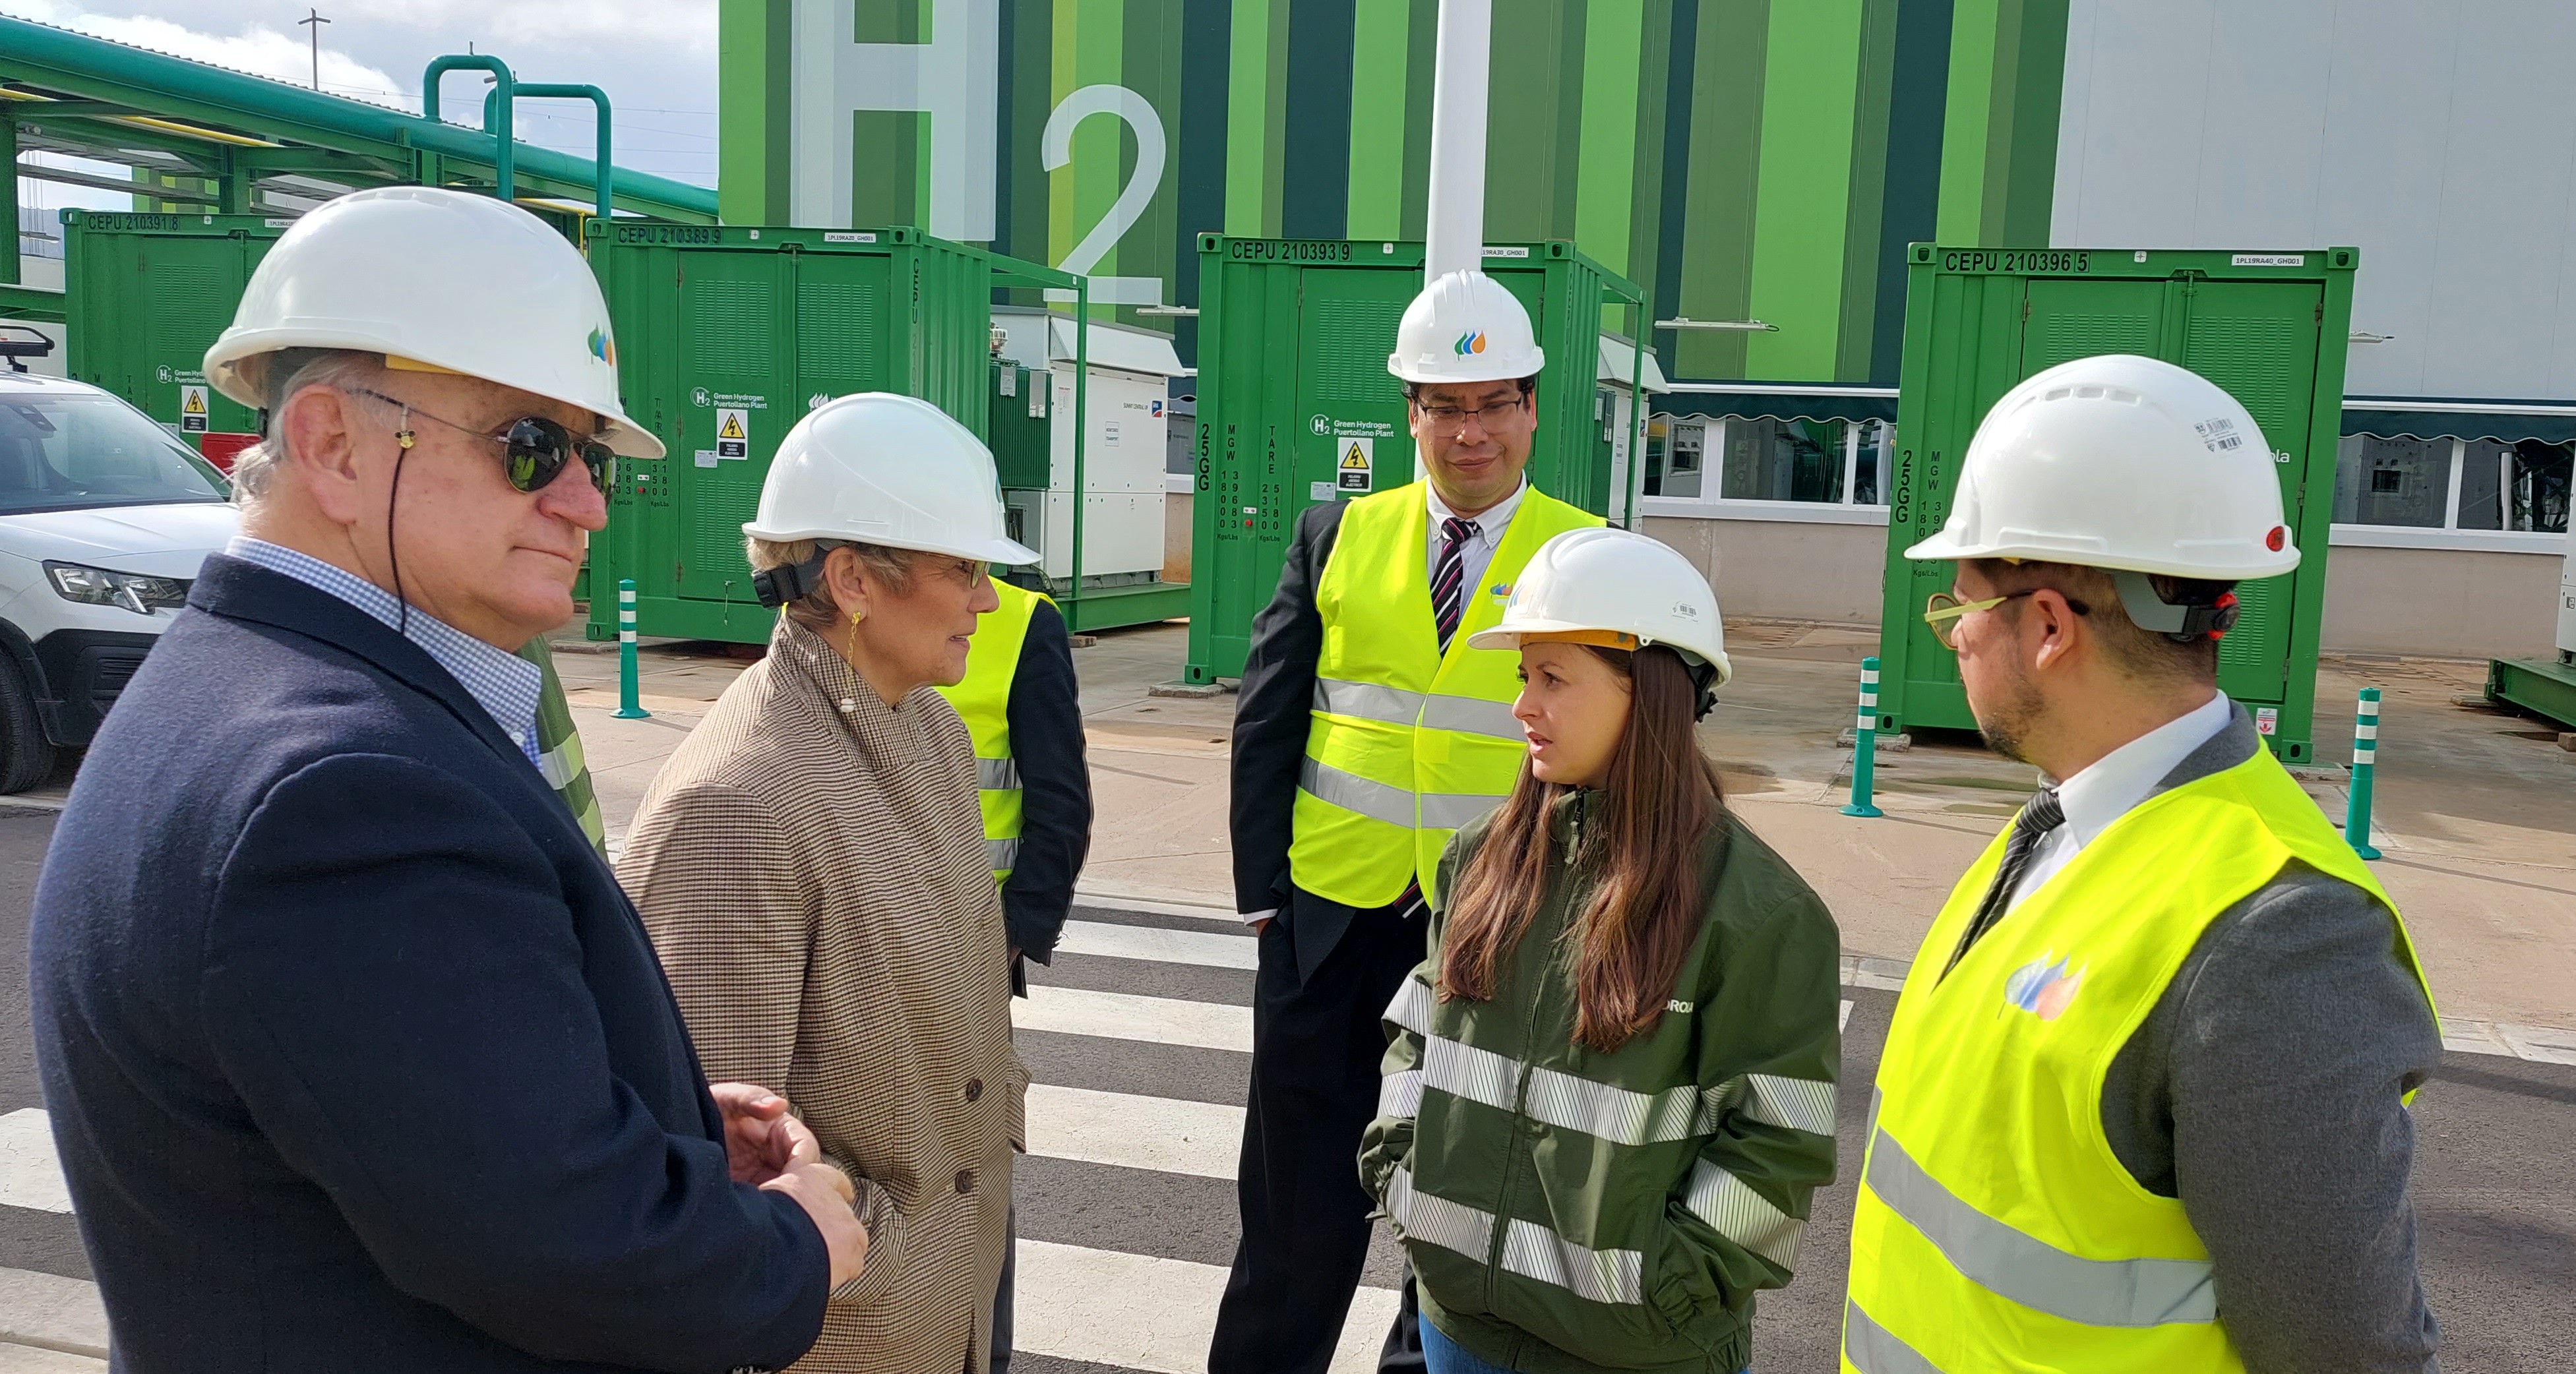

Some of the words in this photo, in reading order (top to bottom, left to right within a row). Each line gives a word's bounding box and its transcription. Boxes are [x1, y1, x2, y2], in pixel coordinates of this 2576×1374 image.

[88, 215, 121, 230] CEPU
[126, 216, 166, 231] 210391
[171, 216, 179, 231] 8
[618, 227, 656, 244] CEPU
[660, 228, 709, 245] 210389
[713, 228, 720, 245] 9
[1232, 242, 1275, 260] CEPU
[1281, 243, 1336, 261] 210393
[1341, 243, 1350, 262] 9
[1945, 252, 1998, 271] CEPU
[2004, 253, 2071, 272] 210396
[2077, 253, 2088, 273] 5
[733, 394, 764, 402] Hydrogen
[1356, 421, 1392, 430] Hydrogen
[1226, 424, 1235, 461] MGW
[1198, 423, 1210, 491] 25GG
[1928, 450, 1941, 491] MGW
[1895, 450, 1912, 523] 25GG
[1259, 534, 1281, 543] Kgs/Lbs
